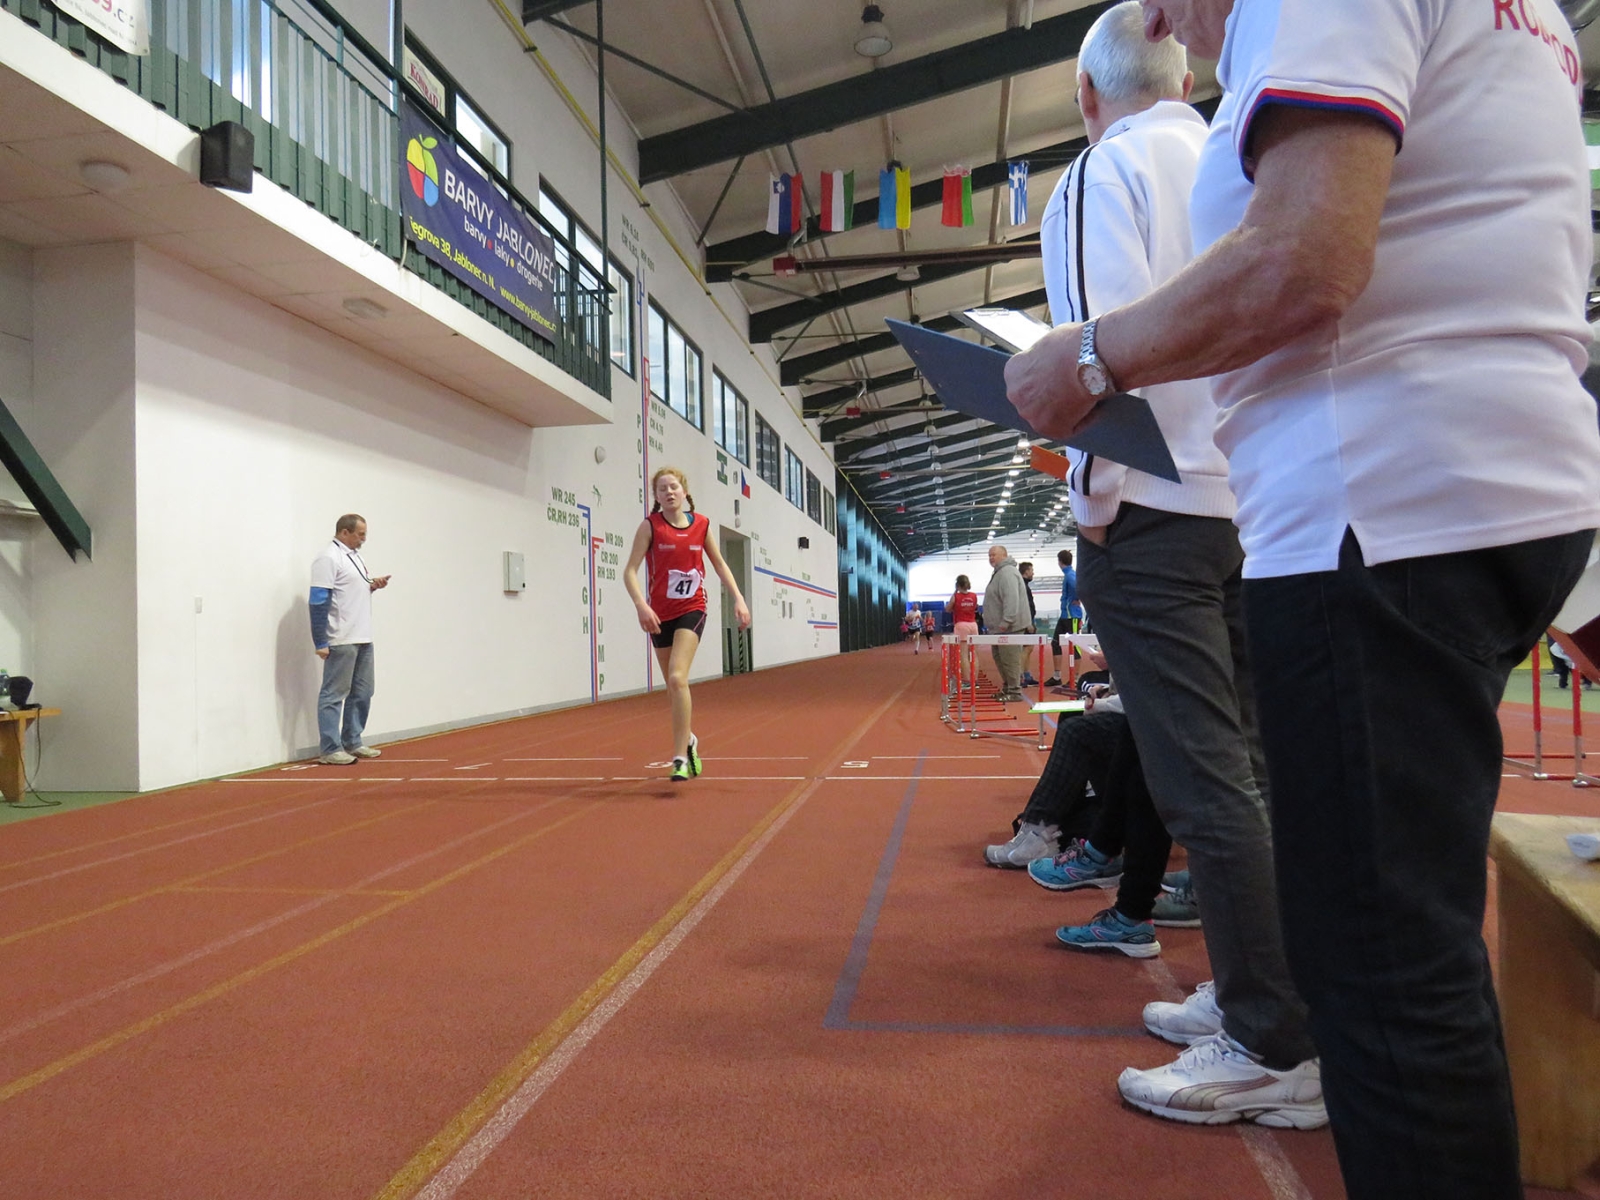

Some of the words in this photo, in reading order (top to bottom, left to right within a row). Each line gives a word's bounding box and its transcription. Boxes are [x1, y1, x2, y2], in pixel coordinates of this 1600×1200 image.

[444, 168, 494, 231] BARVY
[496, 216, 555, 284] JABLONEC
[464, 214, 488, 250] barvy
[494, 239, 511, 267] laky
[516, 259, 543, 291] drogerie
[453, 248, 482, 281] Jablonec
[551, 486, 563, 503] WR
[564, 490, 576, 507] 245
[568, 512, 580, 528] 236
[604, 531, 614, 545] WR
[614, 534, 624, 548] 209
[609, 552, 618, 566] 200
[580, 528, 589, 634] HIGH
[597, 565, 605, 579] RH
[605, 567, 616, 581] 193
[675, 579, 693, 596] 47
[597, 588, 605, 691] JUMP
